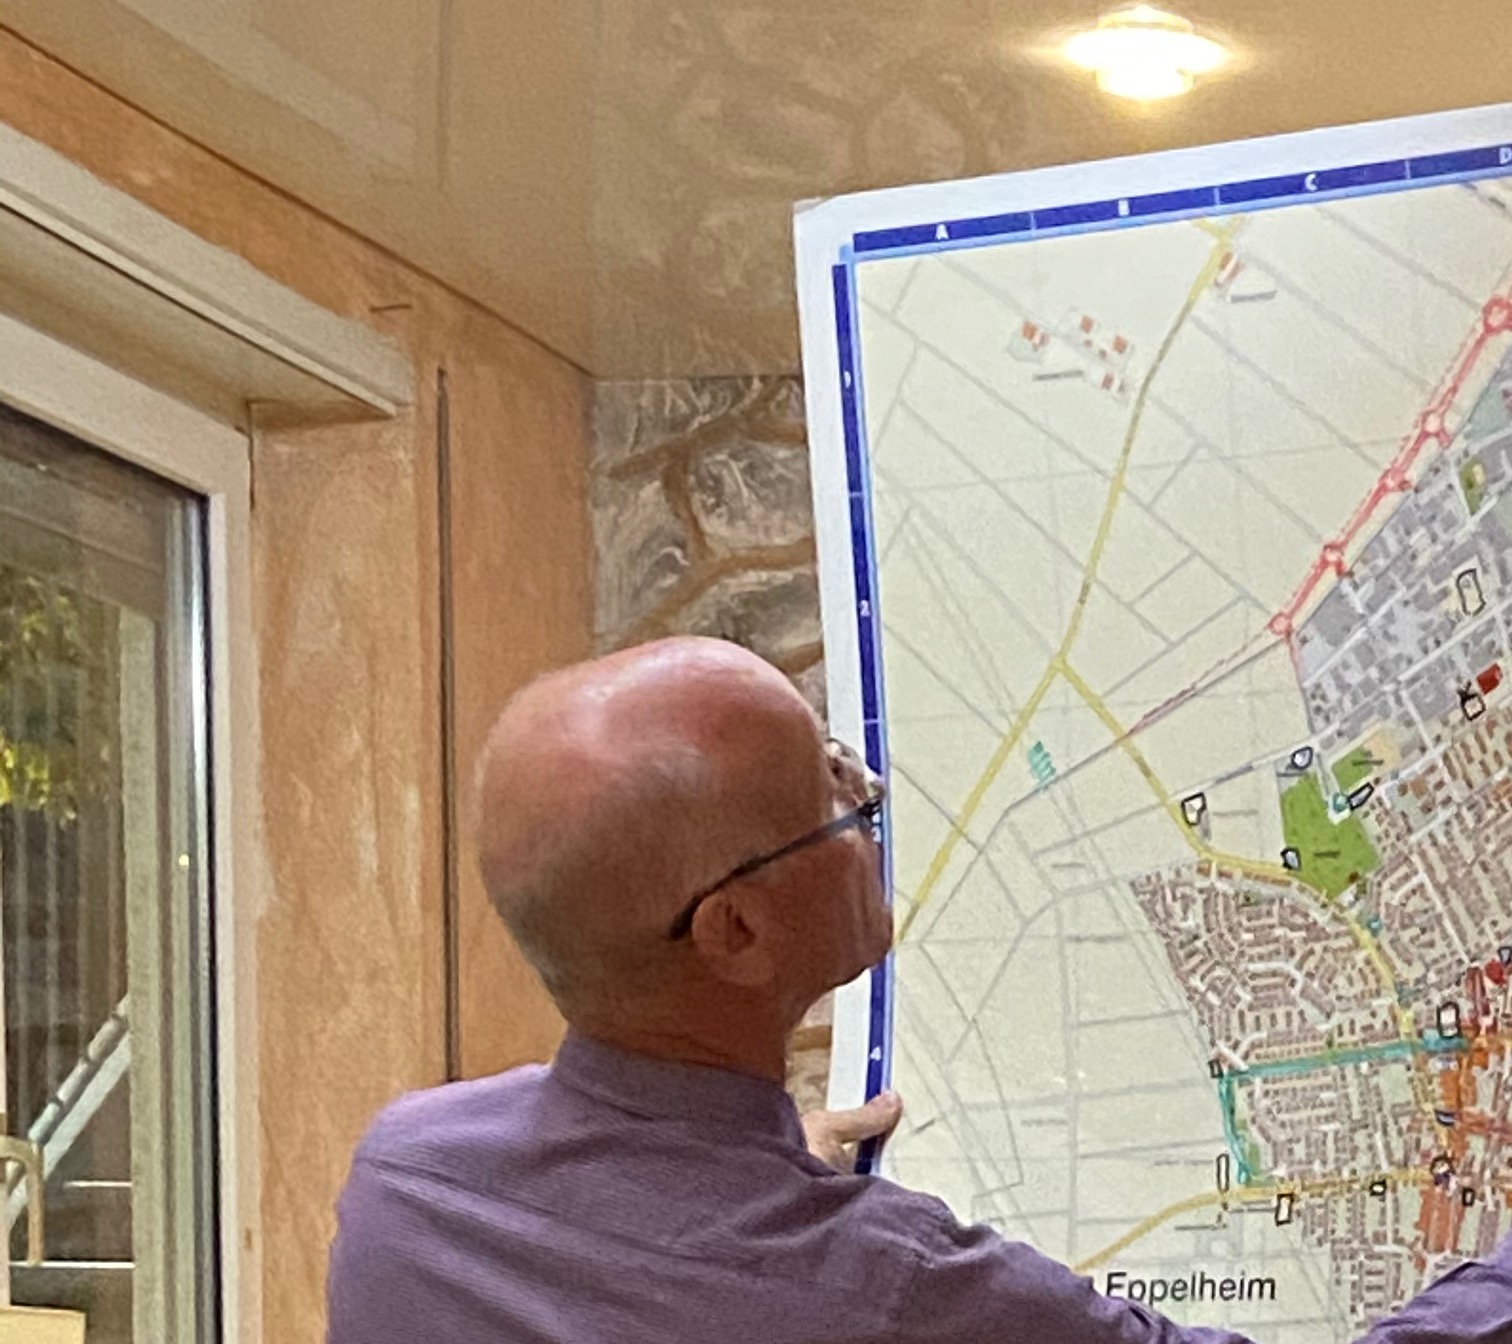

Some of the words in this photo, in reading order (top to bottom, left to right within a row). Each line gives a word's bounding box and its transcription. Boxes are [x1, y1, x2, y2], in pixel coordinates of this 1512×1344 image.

[1304, 173, 1317, 191] C
[935, 223, 949, 241] A
[859, 600, 870, 617] 2
[869, 1046, 882, 1061] 4
[1106, 1270, 1277, 1307] Eppelheim
